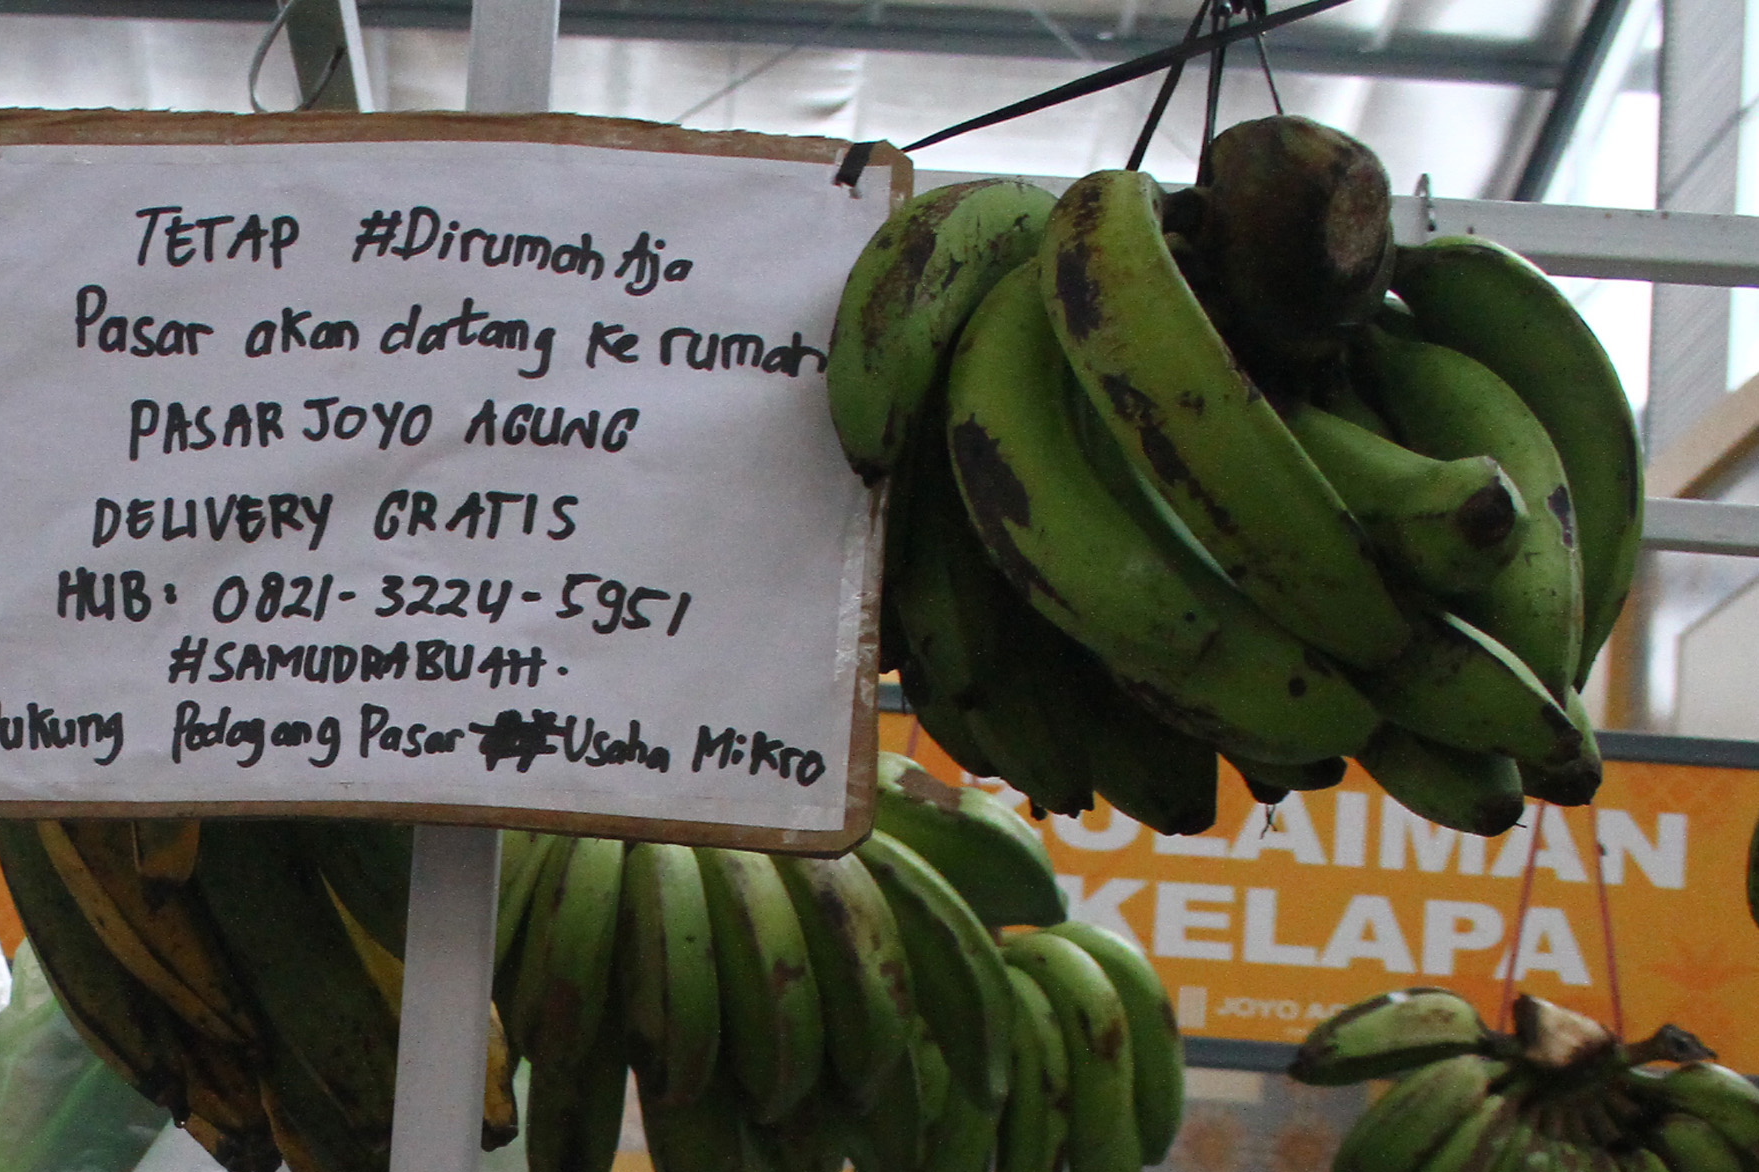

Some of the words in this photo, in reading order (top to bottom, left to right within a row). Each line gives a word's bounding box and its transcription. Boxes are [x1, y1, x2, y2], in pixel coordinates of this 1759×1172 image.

[135, 205, 300, 268] TETAP
[75, 284, 214, 357] Pasar
[380, 298, 556, 379] datang
[659, 326, 828, 378] rumah
[129, 399, 285, 461] PASAR
[302, 396, 433, 450] JOYO
[464, 398, 641, 453] AGUNG
[92, 492, 335, 551] DELIVERY
[373, 488, 580, 541] GRATIS
[359, 702, 467, 758] Pasar
[960, 770, 1689, 890] UAIMAN
[1055, 871, 1592, 987] KELAPA
